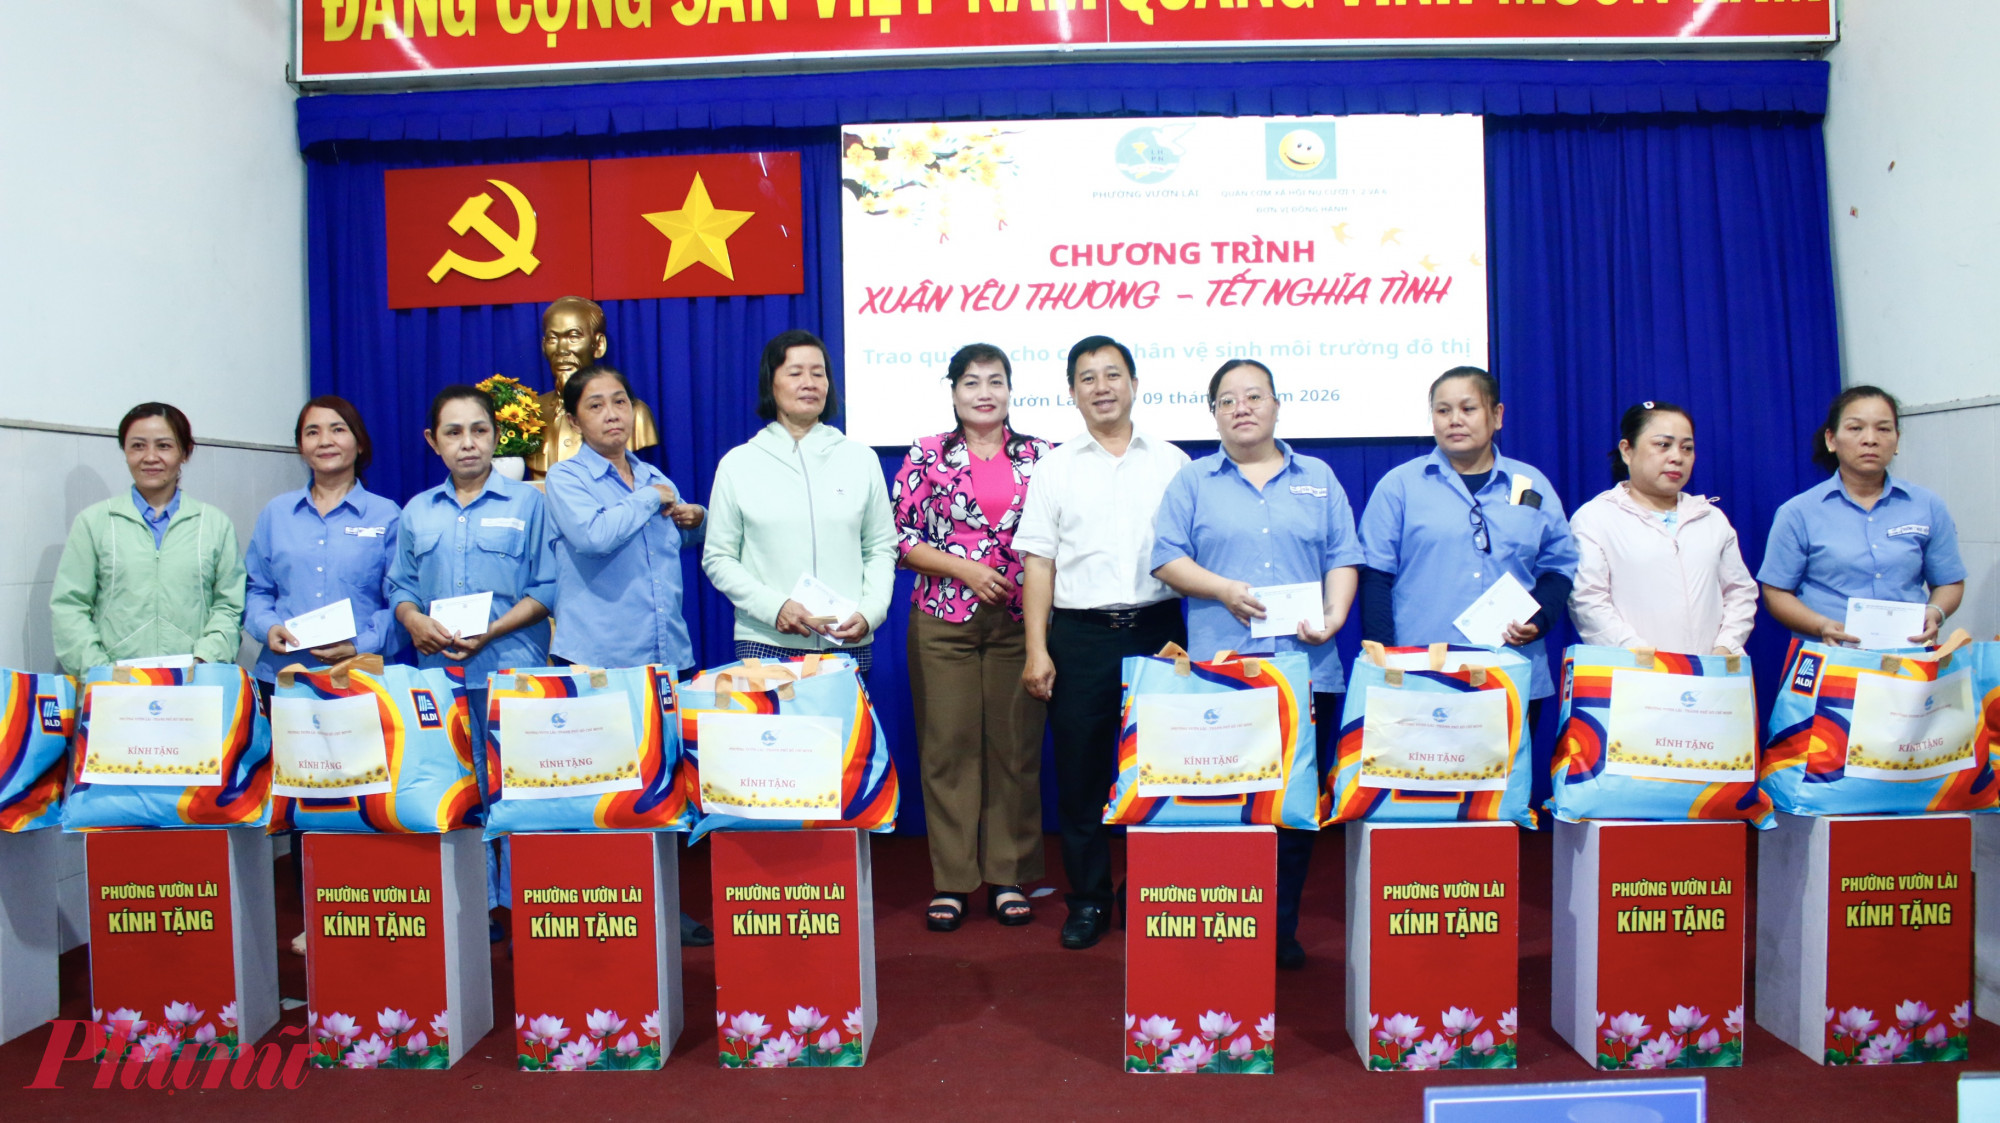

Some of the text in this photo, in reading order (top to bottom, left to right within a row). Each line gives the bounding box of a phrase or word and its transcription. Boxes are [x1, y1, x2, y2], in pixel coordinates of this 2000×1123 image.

[1049, 235, 1315, 268] CHƯƠNG TRÌNH
[858, 279, 954, 315] XUÂN
[960, 278, 1021, 312] YÊU
[1025, 279, 1161, 311] THƯƠNG
[1205, 268, 1267, 307] TẾT
[1262, 272, 1373, 307] NGHĨA
[1379, 270, 1453, 305] TÌNH
[863, 349, 912, 365] Trao
[1010, 345, 1050, 362] cho
[1133, 343, 1175, 360] hân
[1183, 341, 1208, 362] vệ
[1215, 341, 1263, 359] sinh
[1270, 339, 1311, 358] môi
[1319, 339, 1398, 360] trường
[1406, 338, 1434, 356] đô
[1441, 336, 1471, 358] thị
[1011, 394, 1050, 408] ườn
[1142, 393, 1163, 405] 09
[1169, 391, 1208, 404] thán
[1299, 388, 1341, 403] 2026
[1795, 676, 1813, 688] ALDI
[45, 718, 62, 727] ALD
[421, 713, 439, 722] ALDI
[127, 744, 179, 758] KÍNH TẶNG
[1655, 738, 1714, 752] KÍNH TẶNG
[298, 759, 342, 772] KÍNH TẶNG
[539, 756, 593, 770] KÍNH TẶNG
[1184, 755, 1239, 768] KÍNH TẶNG
[1408, 752, 1465, 765] KÍNH TẶNG
[740, 777, 796, 790] KÍNH TẶNG
[101, 879, 218, 900] PHƯỜNG VƯỜN LÀI
[725, 882, 845, 901] PHƯỜNG VƯỜN LÀI
[1383, 879, 1505, 900] PHƯỜNG VƯỜN LÀI
[1611, 877, 1732, 897] PHƯỜNG VƯỜN LÀI
[1841, 874, 1958, 892] PHƯỜNG VƯỜN LÀI
[316, 885, 431, 903] PHƯỜNG VƯỜN LÀI
[523, 885, 642, 904] PHƯỜNG VƯỜN LÀI
[1140, 884, 1263, 903] PHƯỜNG VƯỜN LÀI
[108, 905, 214, 936] KÍNH TẶNG
[732, 909, 840, 939] KÍNH TẶNG
[1389, 907, 1498, 938] KÍNH TẶNG
[1617, 905, 1725, 936] KÍNH TẶNG
[1846, 899, 1951, 930] KÍNH TẶNG
[323, 911, 426, 941] KÍNH TẶNG
[531, 912, 638, 942] KÍNH TẶNG
[1146, 911, 1256, 943] KÍNH TẶNG
